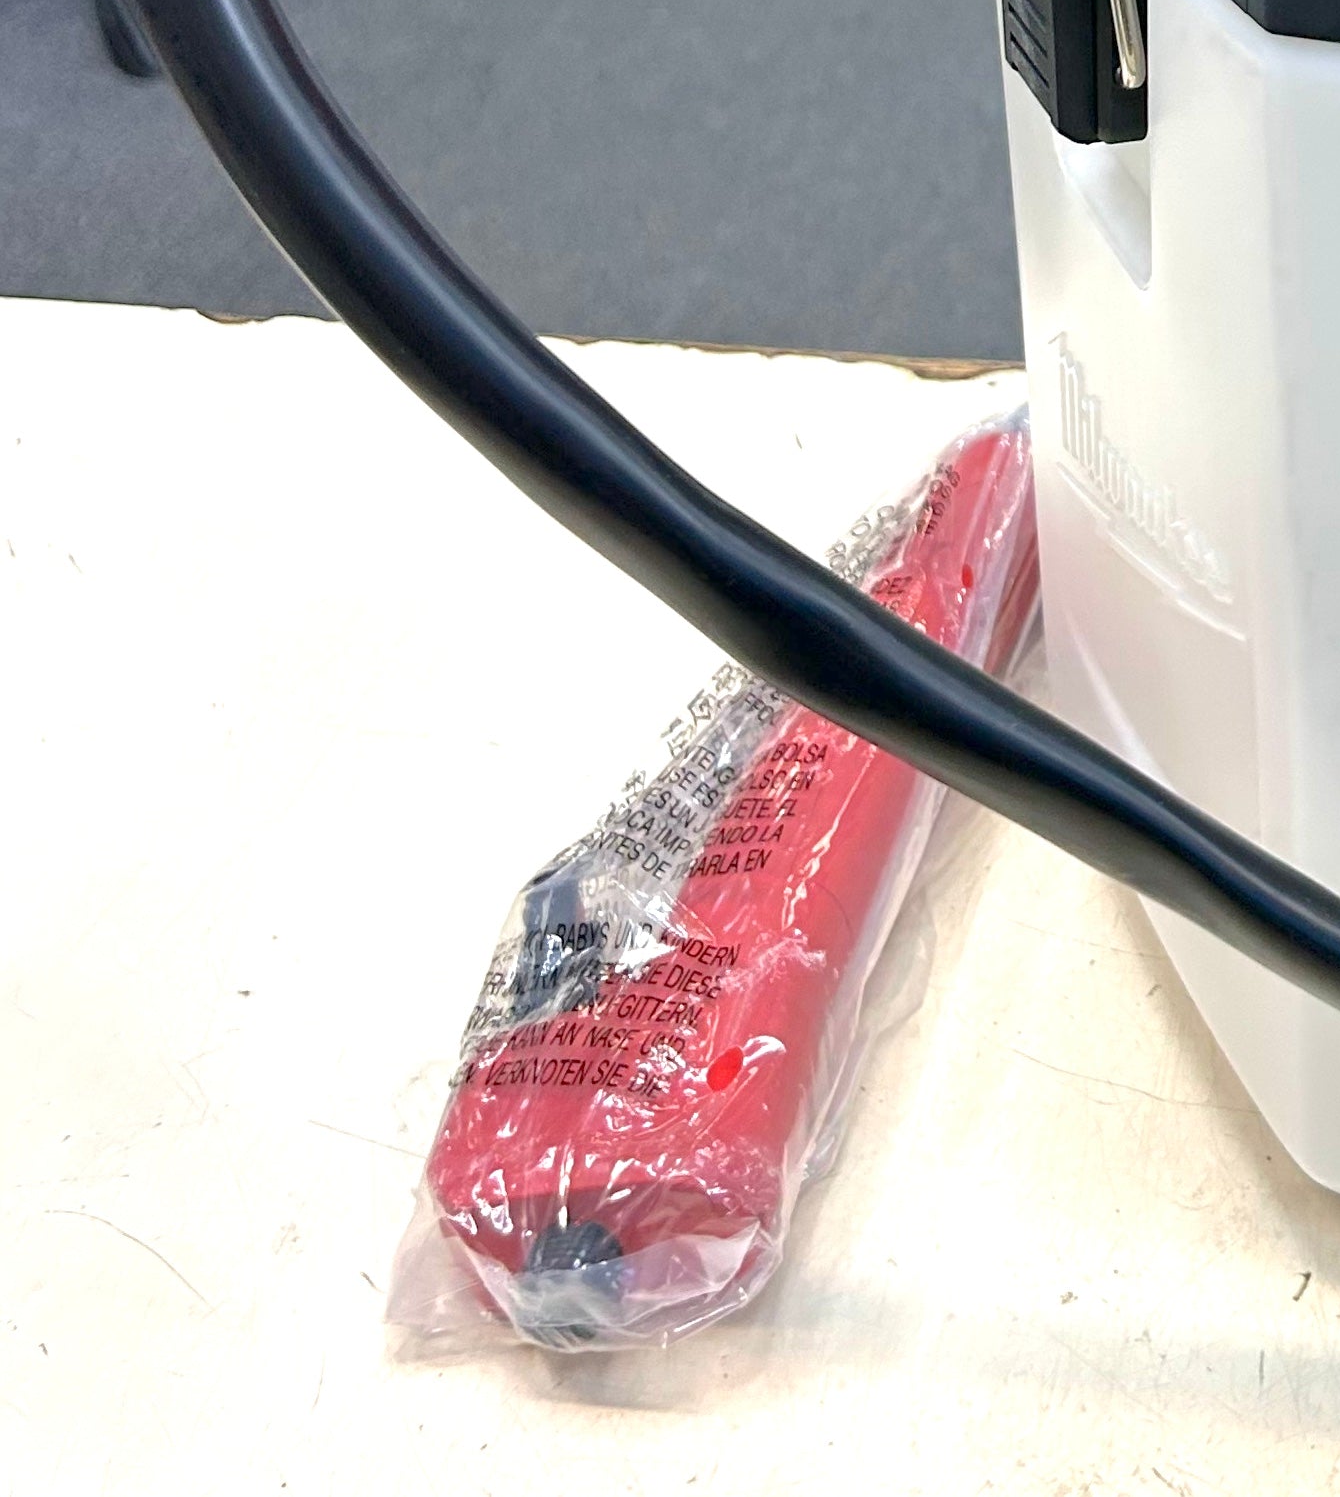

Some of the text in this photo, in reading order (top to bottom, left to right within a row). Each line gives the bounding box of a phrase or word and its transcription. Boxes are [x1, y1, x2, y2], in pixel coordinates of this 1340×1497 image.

[771, 743, 828, 763] BOLSA
[759, 824, 785, 842] LA
[641, 849, 773, 881] DE EN
[551, 1020, 579, 1046] AN
[582, 1026, 640, 1052] NASE
[483, 1058, 588, 1088] VERKNOTEN
[591, 1058, 630, 1088] SIE
